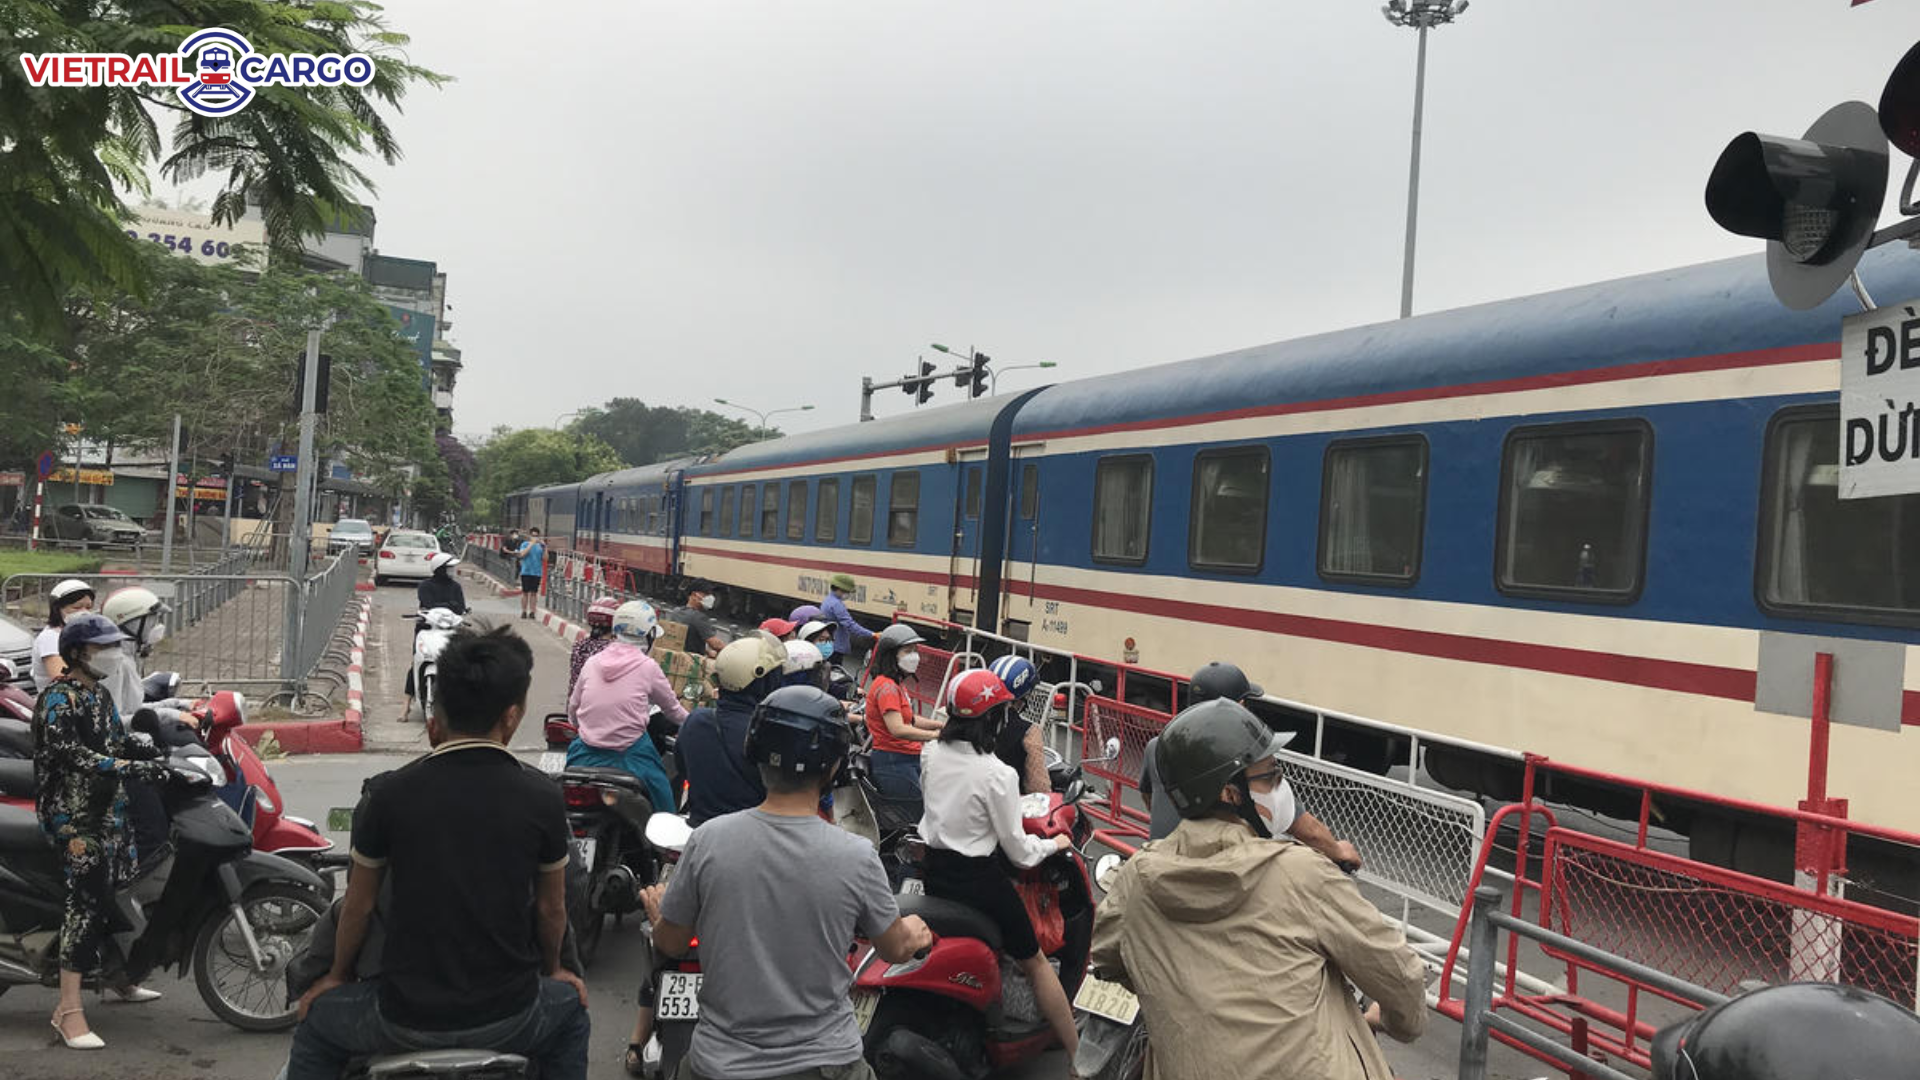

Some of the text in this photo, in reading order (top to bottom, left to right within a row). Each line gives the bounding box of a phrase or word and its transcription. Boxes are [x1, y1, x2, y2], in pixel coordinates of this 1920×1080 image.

[1846, 399, 1920, 467] DỪ
[1045, 601, 1060, 615] SRT
[661, 997, 700, 1017] 553.
[1086, 990, 1130, 1019] 1820
